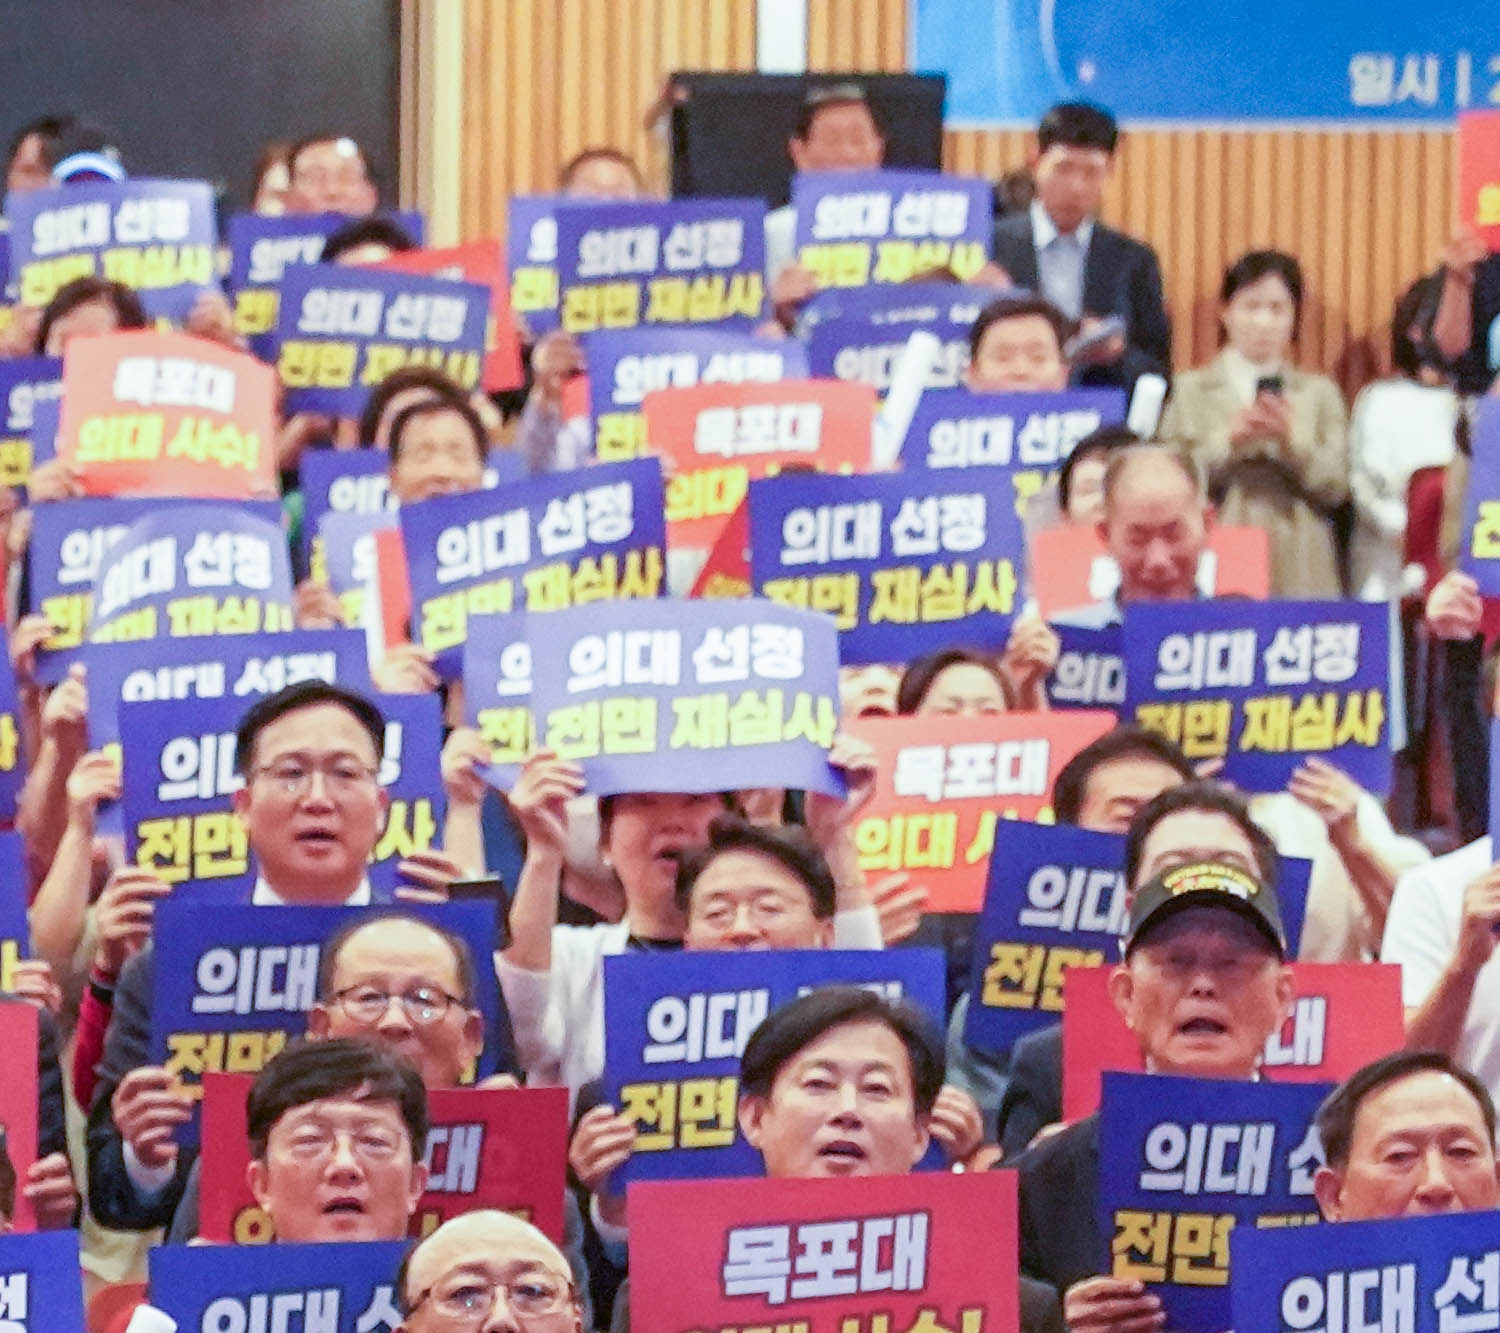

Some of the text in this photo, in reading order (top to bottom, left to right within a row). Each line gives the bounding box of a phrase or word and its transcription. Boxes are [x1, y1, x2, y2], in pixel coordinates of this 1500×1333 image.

[437, 482, 633, 583] 의대 선정
[781, 494, 986, 565] 의대 선정
[568, 624, 803, 693] 의대 선정
[1155, 624, 1359, 689] 의대 선정
[547, 692, 835, 765] 전면 재심사
[1242, 692, 1383, 750] 재심사
[1141, 1124, 1275, 1194] 의대
[724, 1214, 927, 1303] 목포대
[1102, 1211, 1233, 1290] 전면
